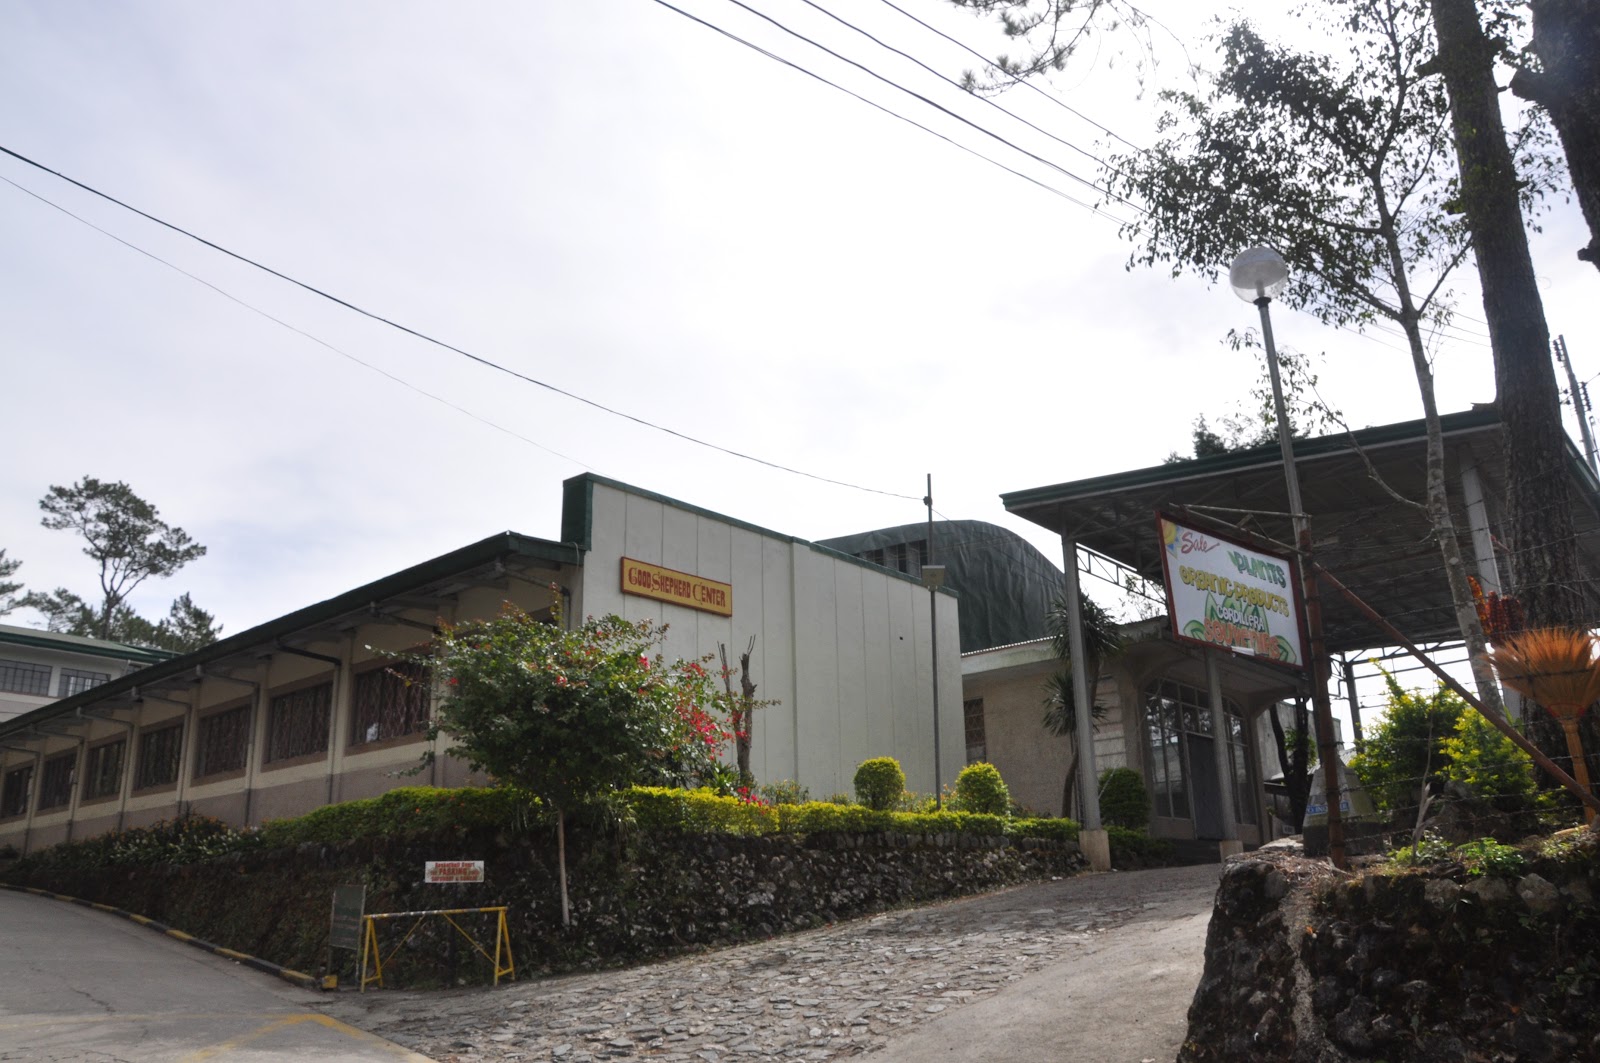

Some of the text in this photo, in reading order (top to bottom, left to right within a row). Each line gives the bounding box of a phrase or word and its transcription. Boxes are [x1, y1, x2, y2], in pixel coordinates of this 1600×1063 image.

[1180, 532, 1220, 554] Sale
[628, 567, 726, 607] GOOD SHEPHERD CENTER
[1232, 551, 1287, 588] PLANTS
